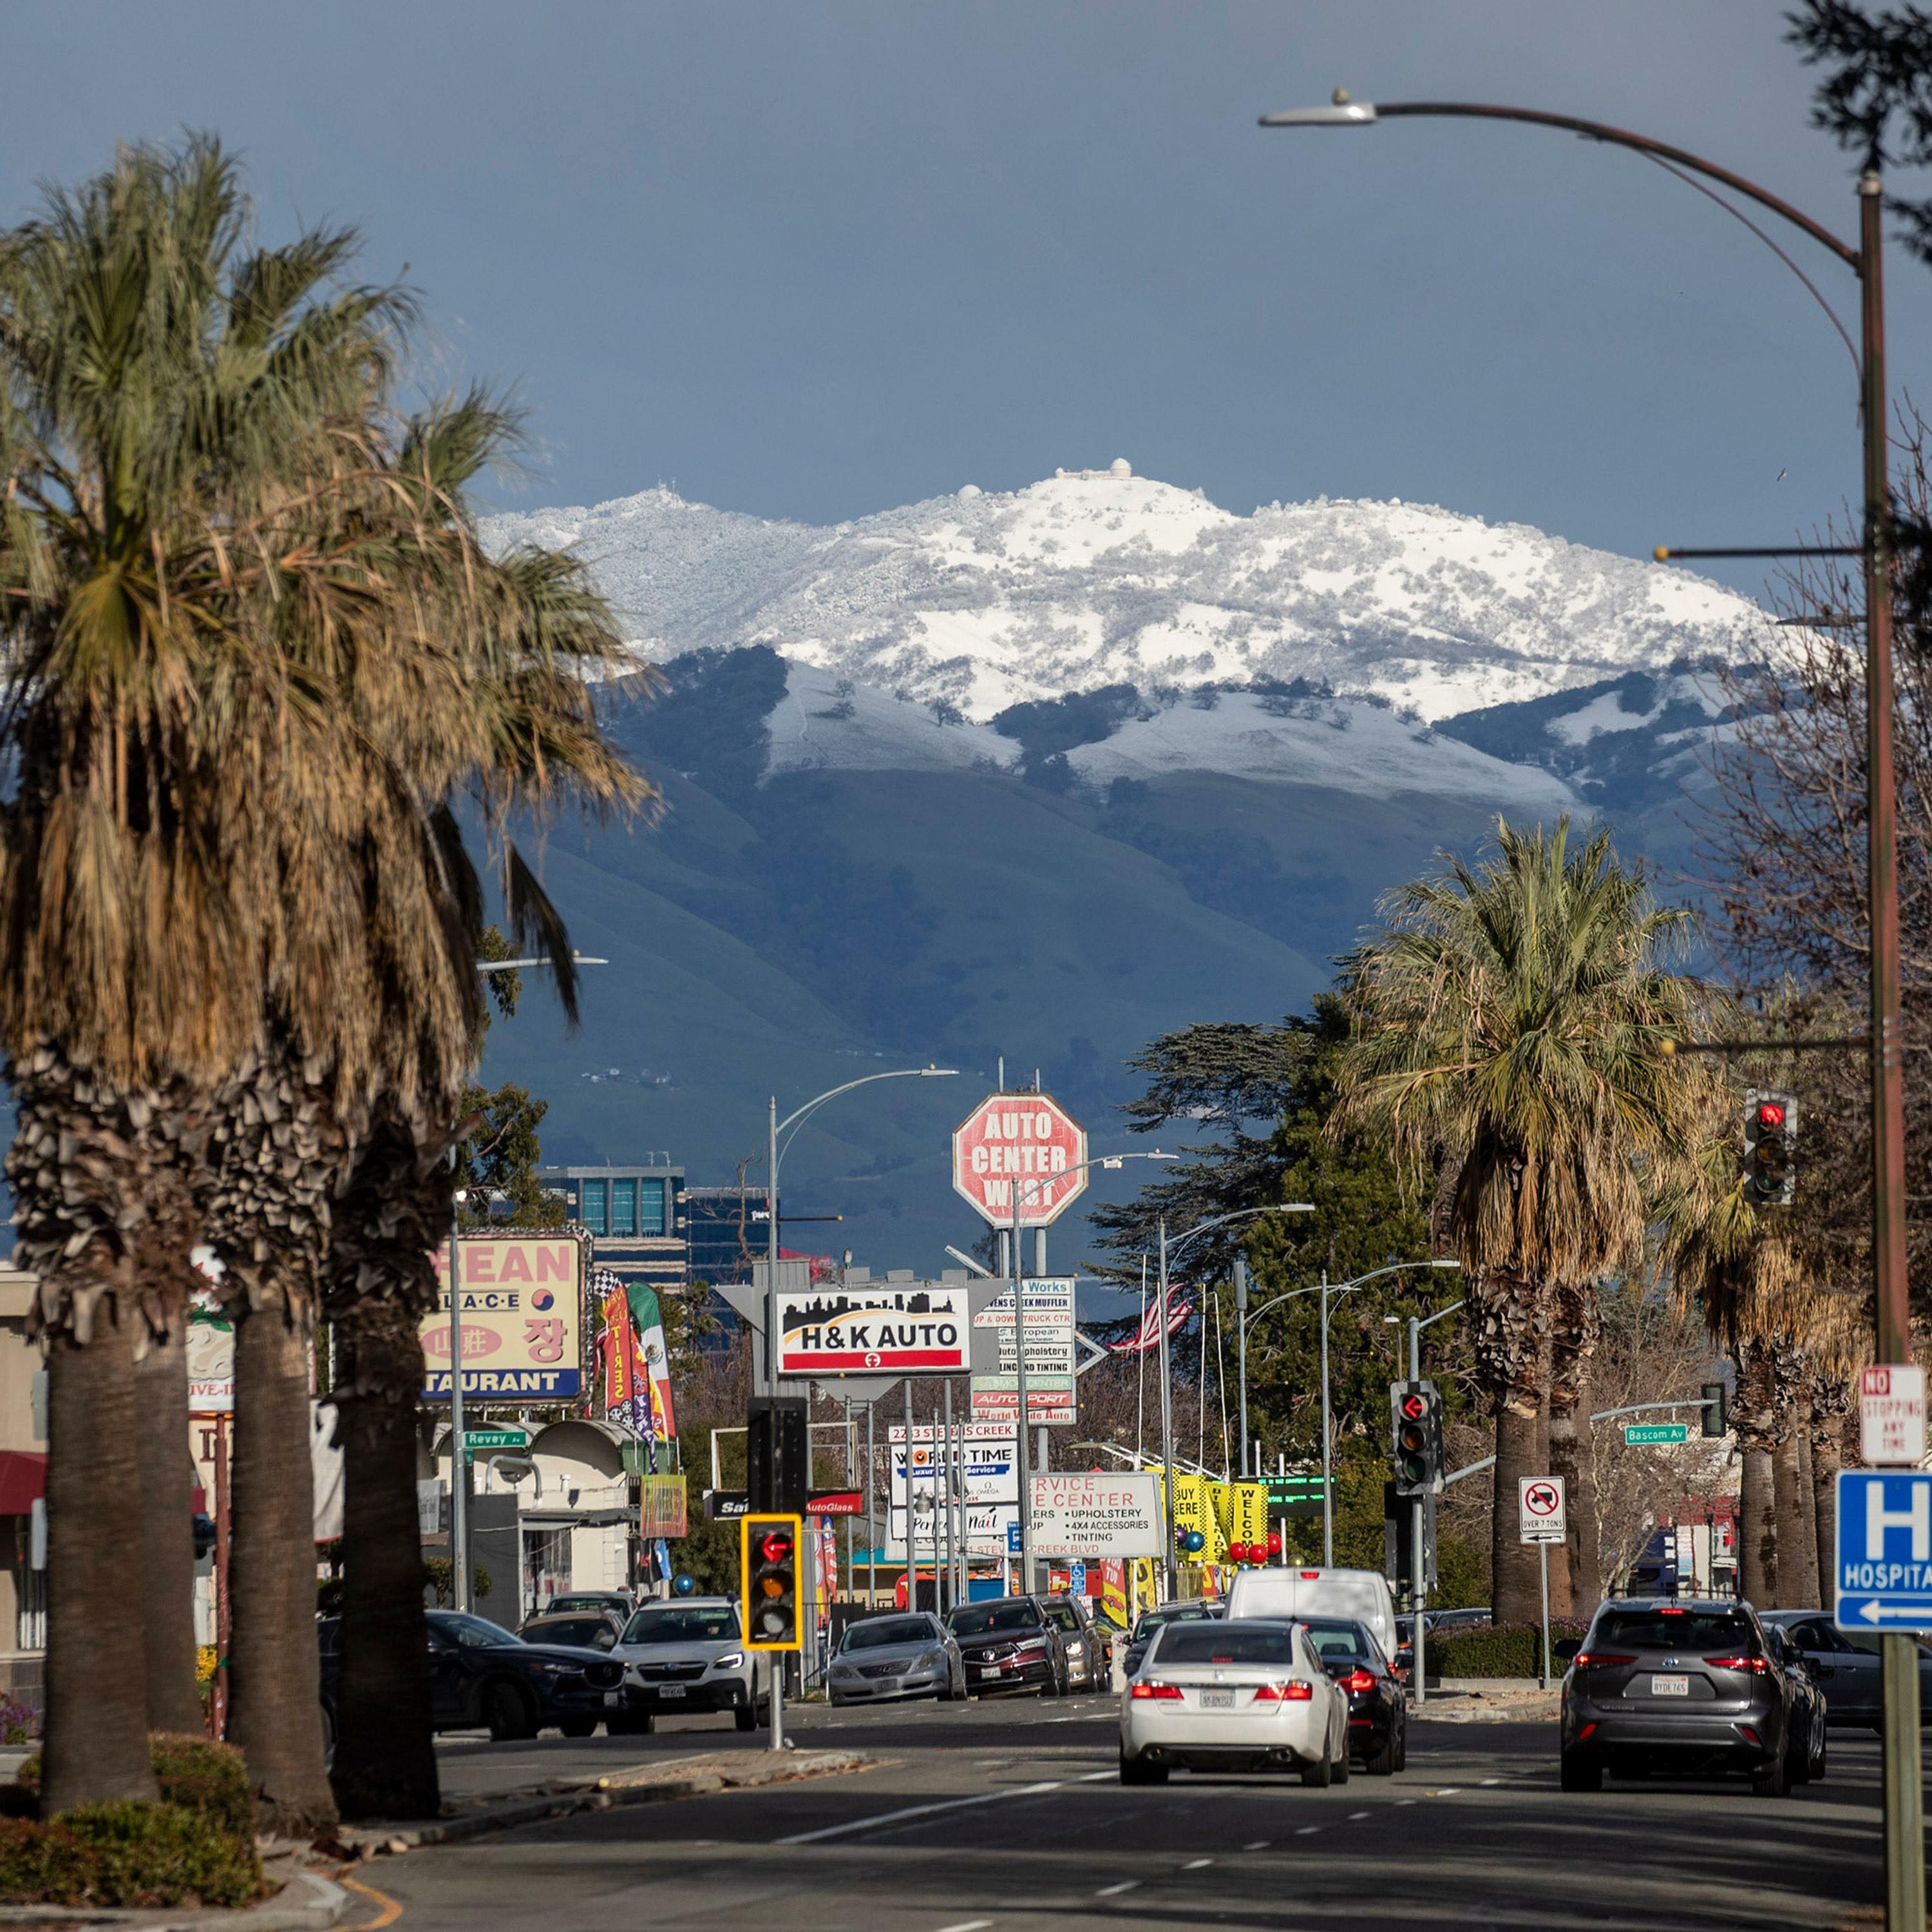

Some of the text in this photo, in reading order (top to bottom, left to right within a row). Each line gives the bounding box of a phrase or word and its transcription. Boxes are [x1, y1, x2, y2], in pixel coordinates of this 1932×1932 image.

[984, 1112, 1052, 1139] AUTO
[971, 1146, 1066, 1173] CENTER
[430, 1246, 570, 1283] REAN
[1028, 1282, 1066, 1293] Works
[987, 1298, 1067, 1307] VENS CEEK MUFFLER
[996, 1314, 1017, 1323] DOW
[877, 1323, 957, 1348] AUTO
[1010, 1329, 1059, 1338] Eropean
[522, 1318, 567, 1363] 장
[999, 1347, 1068, 1356] uto pholstery
[426, 1372, 560, 1392] TAURANT
[1866, 1371, 1888, 1394] NO
[187, 1383, 235, 1396] IVE-I
[978, 1395, 1068, 1403] AUTOPORT
[977, 1410, 1010, 1420] World
[1045, 1408, 1070, 1420] Auto
[1864, 1399, 1922, 1416] STOPPING
[894, 1428, 920, 1439] 223
[976, 1425, 1012, 1435] CREEK
[1882, 1422, 1905, 1433] ANY
[469, 1434, 506, 1445] Revey
[1629, 1429, 1683, 1440] Bascom Av
[1882, 1438, 1905, 1452] TIME
[970, 1449, 1012, 1463] TIME
[1030, 1477, 1095, 1491] RVICE
[1054, 1493, 1133, 1507] CENTER
[806, 1502, 853, 1513] AutoGlass
[1071, 1508, 1142, 1519] UPHOLSTERY
[1031, 1510, 1055, 1519] ERS
[1242, 1490, 1255, 1548] WELCOM
[1866, 1481, 1930, 1561] H
[969, 1514, 998, 1530] Nail
[1090, 1520, 1149, 1530] ACCESSORIES
[1072, 1533, 1113, 1542] TINTING
[978, 1546, 1005, 1554] STEV
[1071, 1545, 1099, 1553] BLVD
[1844, 1563, 1932, 1589] HOSPITA
